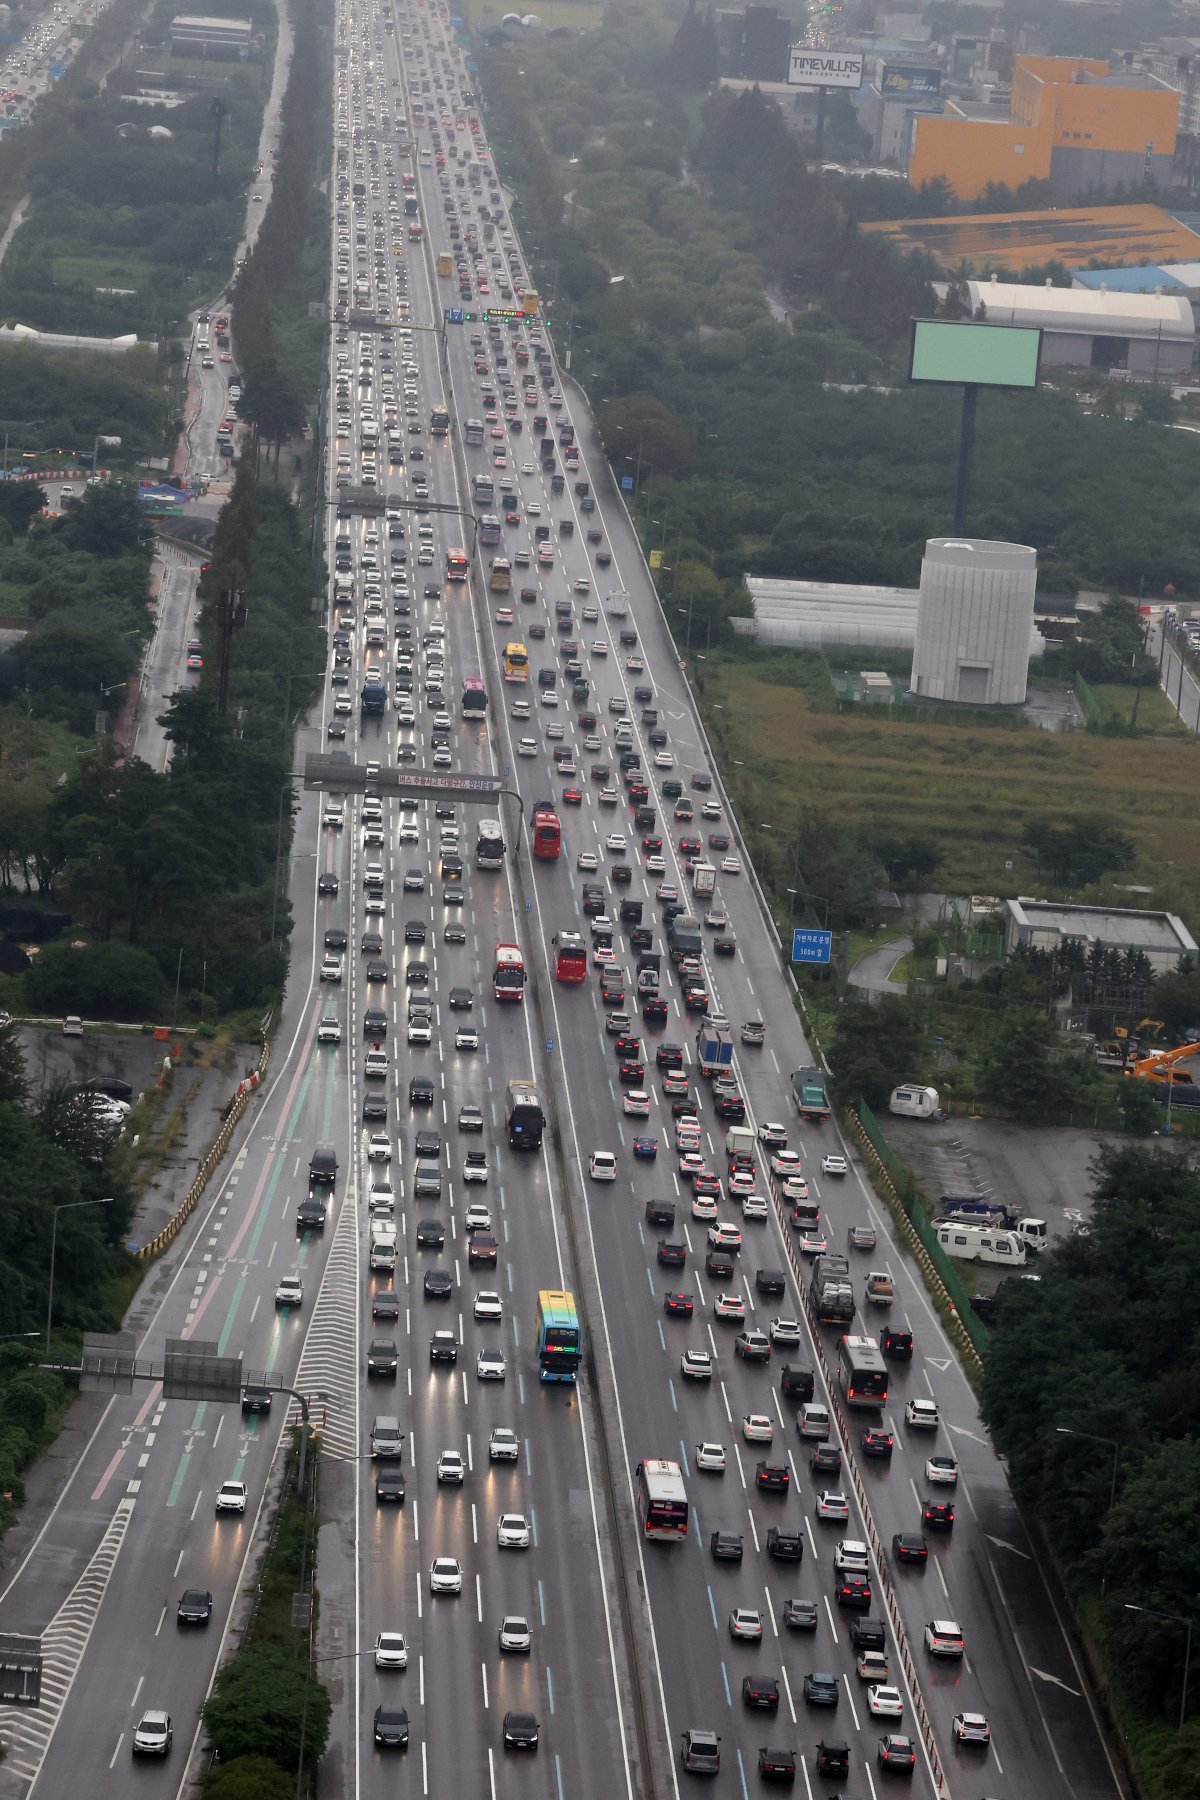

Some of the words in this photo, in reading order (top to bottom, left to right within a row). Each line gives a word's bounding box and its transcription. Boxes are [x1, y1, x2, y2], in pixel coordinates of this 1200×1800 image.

[792, 57, 860, 73] TIMEVILLAS
[400, 776, 412, 784] 버스
[414, 776, 439, 786] 추돌사고
[470, 780, 494, 790] 안전운행
